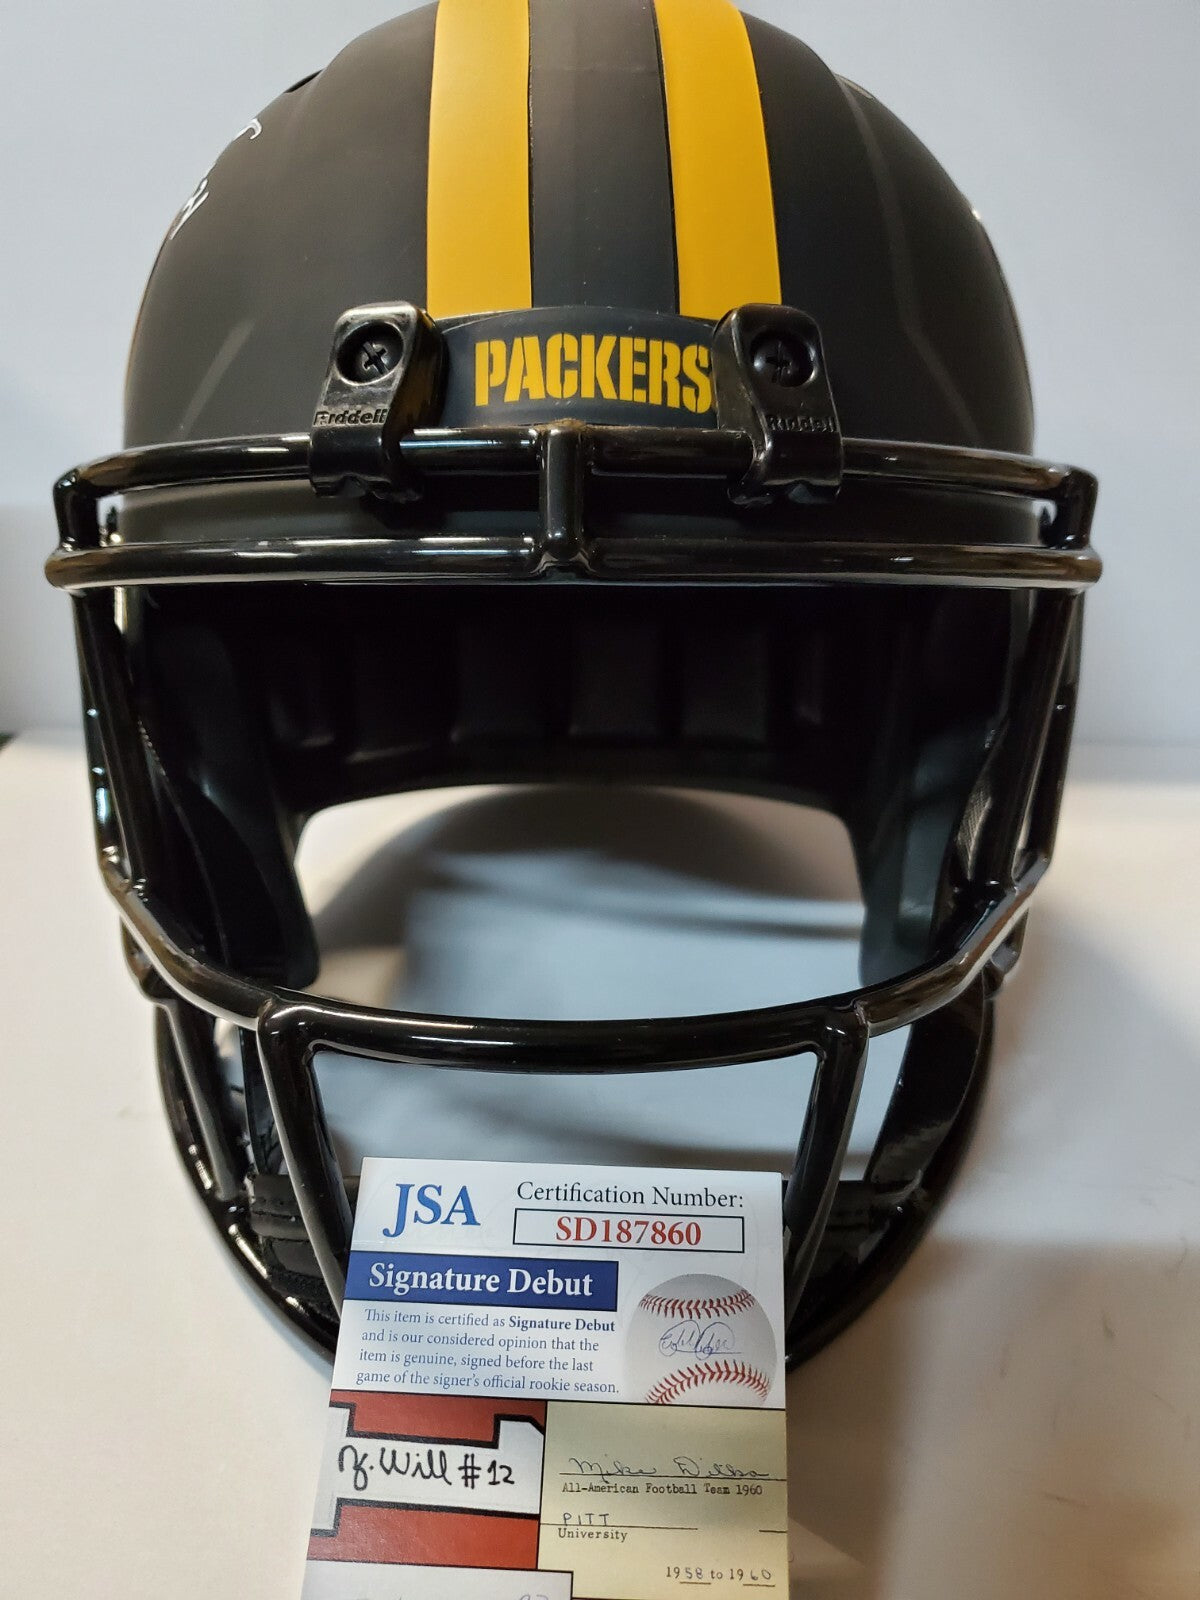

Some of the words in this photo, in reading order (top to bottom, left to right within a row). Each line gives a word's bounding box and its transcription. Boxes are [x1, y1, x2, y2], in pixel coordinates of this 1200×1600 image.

[474, 332, 712, 414] PACKERS
[516, 1181, 645, 1205] Certification
[651, 1186, 744, 1208] Number:
[382, 1182, 481, 1238] JSA
[555, 1215, 702, 1246] SD187860
[369, 1262, 499, 1296] Signature
[506, 1267, 594, 1297] Debut
[364, 1308, 391, 1322] This
[394, 1310, 421, 1324] item
[424, 1312, 435, 1324] is
[438, 1312, 489, 1327] certified
[493, 1317, 505, 1328] as
[508, 1315, 572, 1332] Signature
[575, 1318, 616, 1332] Debut
[361, 1328, 385, 1342] and
[388, 1330, 398, 1343] is
[401, 1333, 424, 1344] our
[426, 1332, 495, 1347] considered
[498, 1335, 547, 1352] opinion
[551, 1337, 576, 1350] that
[579, 1338, 600, 1352] the
[359, 1348, 387, 1362] item
[391, 1350, 401, 1363] is
[403, 1352, 458, 1367] genuine,
[460, 1353, 502, 1370] signed
[505, 1354, 546, 1370] before
[549, 1357, 569, 1371] the
[572, 1357, 594, 1372] last
[355, 1371, 391, 1385] game
[394, 1370, 409, 1384] of
[410, 1371, 430, 1385] the
[483, 1374, 526, 1389] official
[529, 1377, 571, 1391] rookie
[573, 1380, 620, 1394] season.
[562, 1482, 640, 1495] All-American
[645, 1483, 698, 1495] Football
[703, 1484, 731, 1495] Team
[735, 1484, 763, 1496] 1960
[562, 1512, 610, 1526] PITT
[557, 1527, 628, 1542] University
[710, 1569, 724, 1580] to
